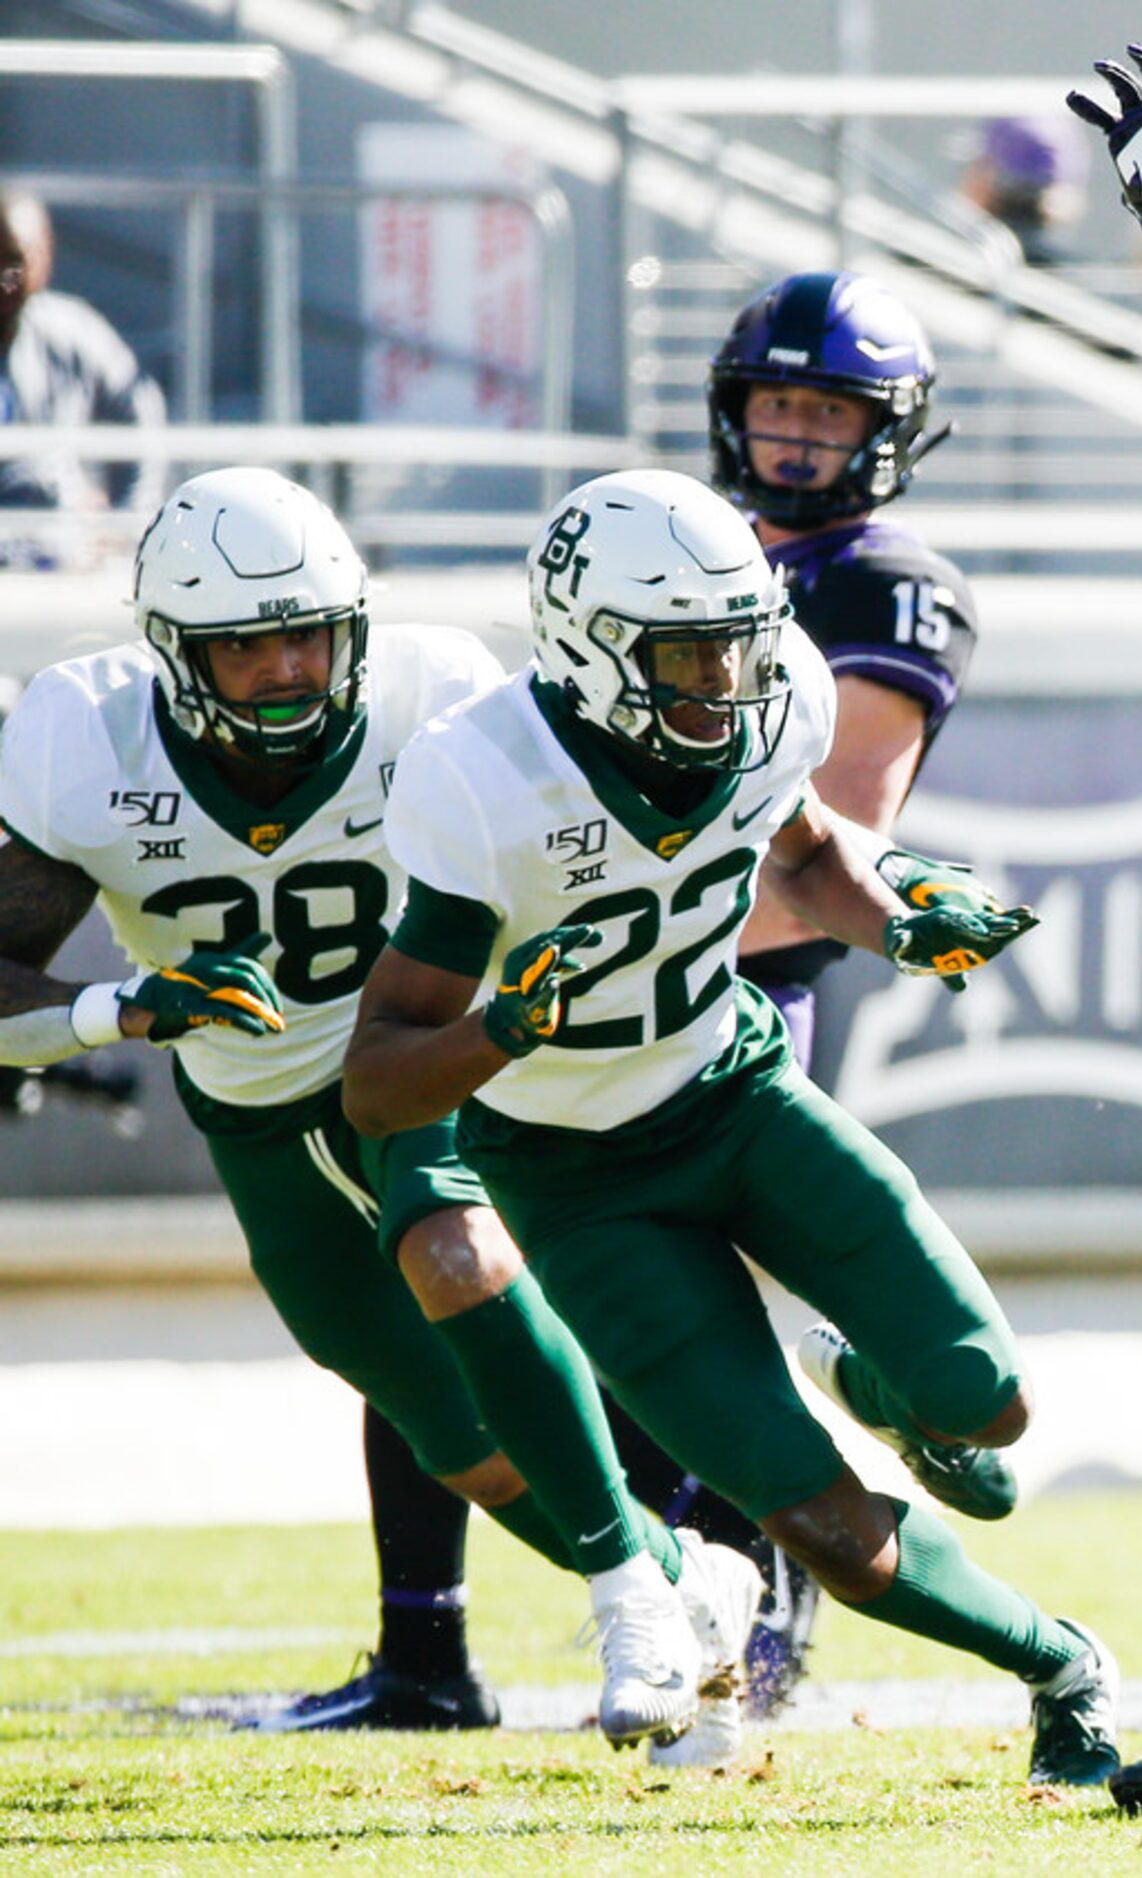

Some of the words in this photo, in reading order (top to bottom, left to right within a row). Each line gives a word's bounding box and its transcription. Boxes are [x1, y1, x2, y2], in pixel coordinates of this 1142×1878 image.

[258, 597, 299, 618] BEARS
[892, 576, 953, 651] 15
[547, 847, 758, 1050] 22
